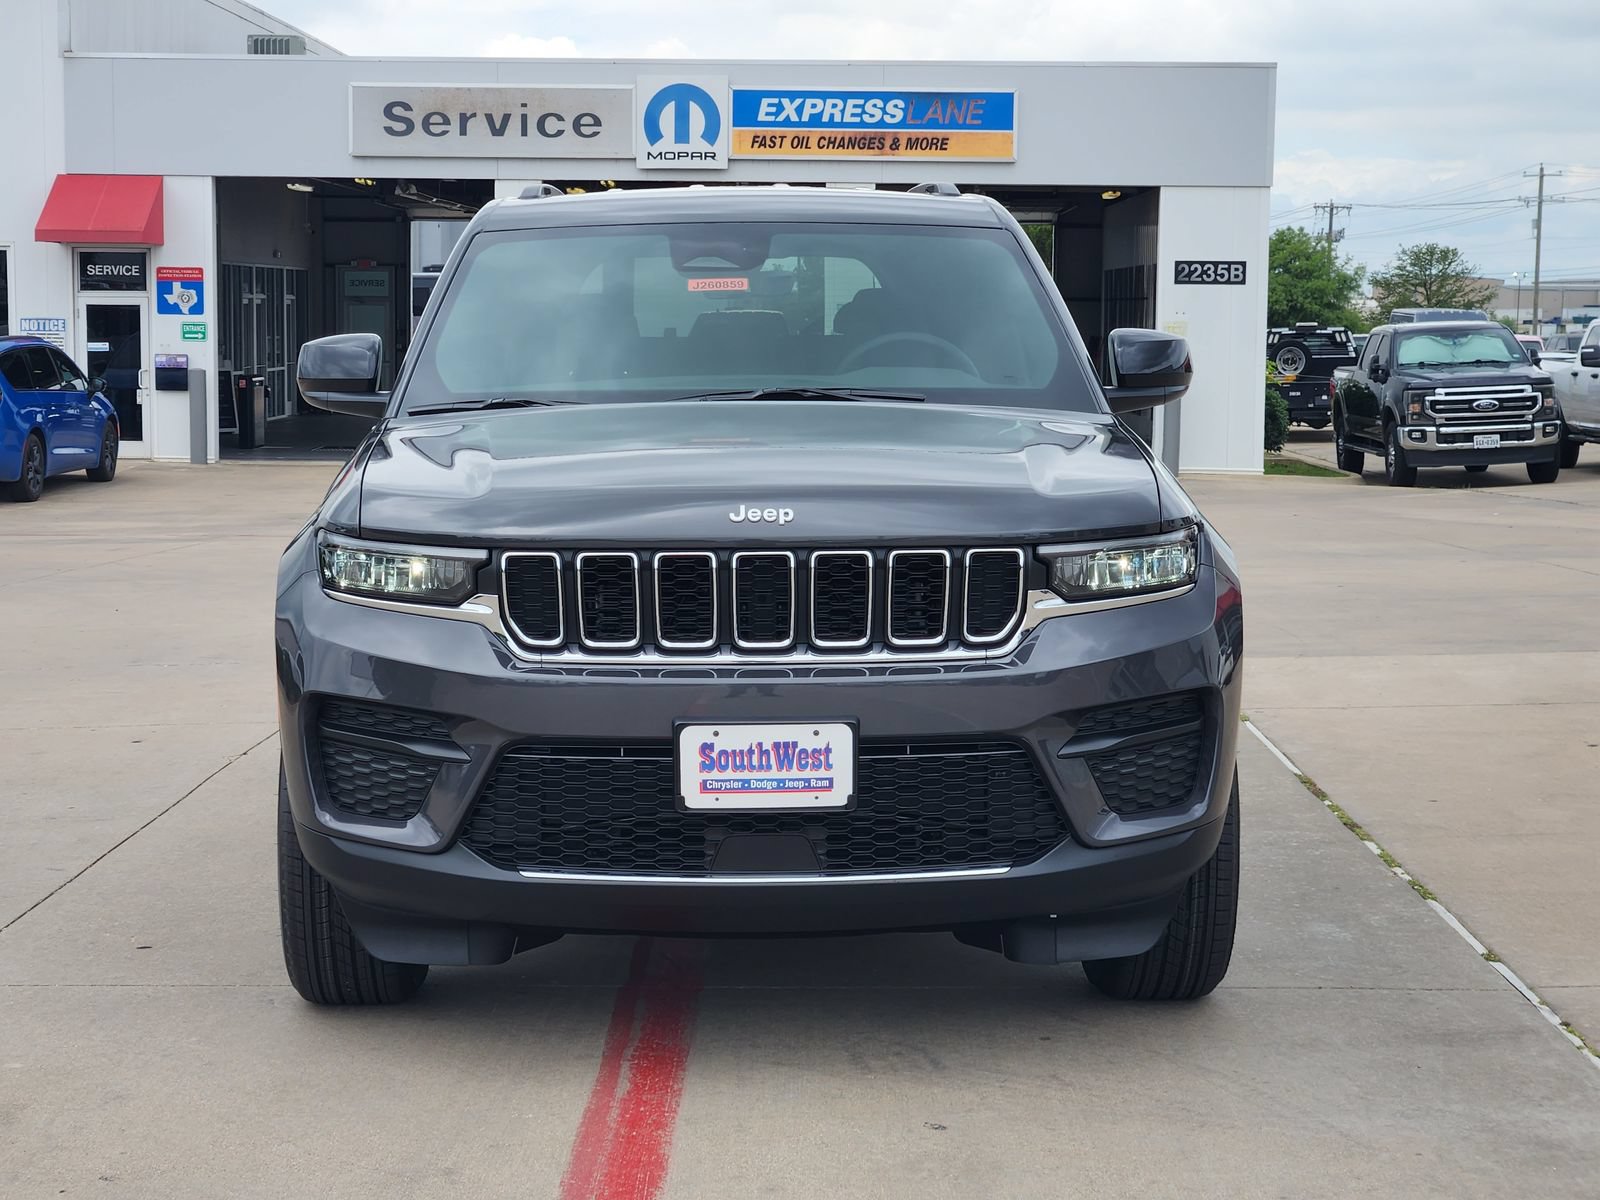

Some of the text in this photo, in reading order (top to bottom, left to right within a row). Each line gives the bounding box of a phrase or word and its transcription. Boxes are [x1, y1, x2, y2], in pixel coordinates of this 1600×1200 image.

[383, 100, 603, 139] Service
[750, 135, 950, 151] FAST OIL CHANGES & MORE
[647, 151, 718, 161] MOPAR
[86, 264, 140, 276] SERVICE
[1177, 263, 1244, 282] 2235B
[692, 280, 744, 290] J260859
[21, 319, 65, 331] NOTICE
[729, 504, 794, 526] Jeep
[698, 741, 833, 773] SouthWest
[706, 779, 829, 791] Chrysler Dodge Jeep Ram
